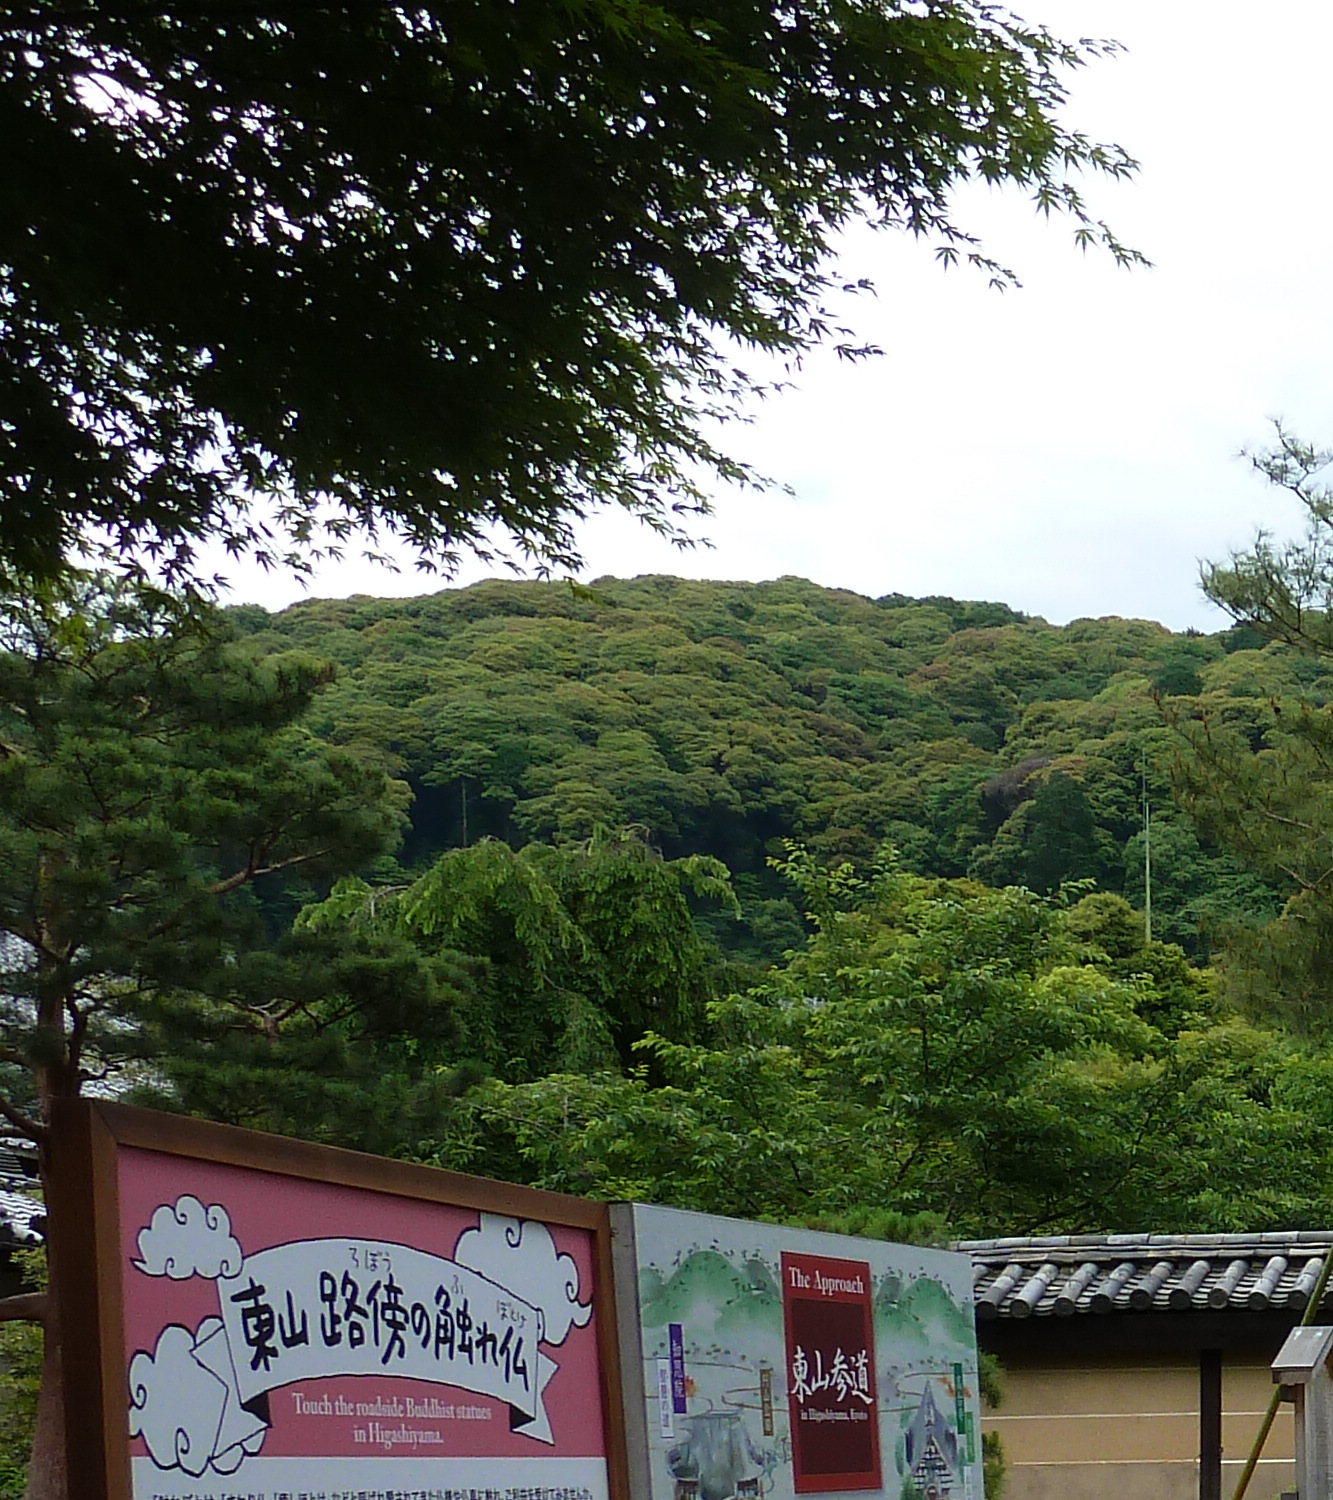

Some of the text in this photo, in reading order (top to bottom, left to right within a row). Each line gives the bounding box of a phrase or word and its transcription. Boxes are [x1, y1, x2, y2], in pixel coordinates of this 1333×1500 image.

[348, 1247, 392, 1273] ろぼう
[789, 1266, 864, 1296] The Approach
[231, 1270, 530, 1392] 東山路傍の触れ仏
[790, 1344, 872, 1405] 東山参道
[292, 1394, 492, 1421] Touch the roadside Buddhist statues
[353, 1424, 366, 1444] in
